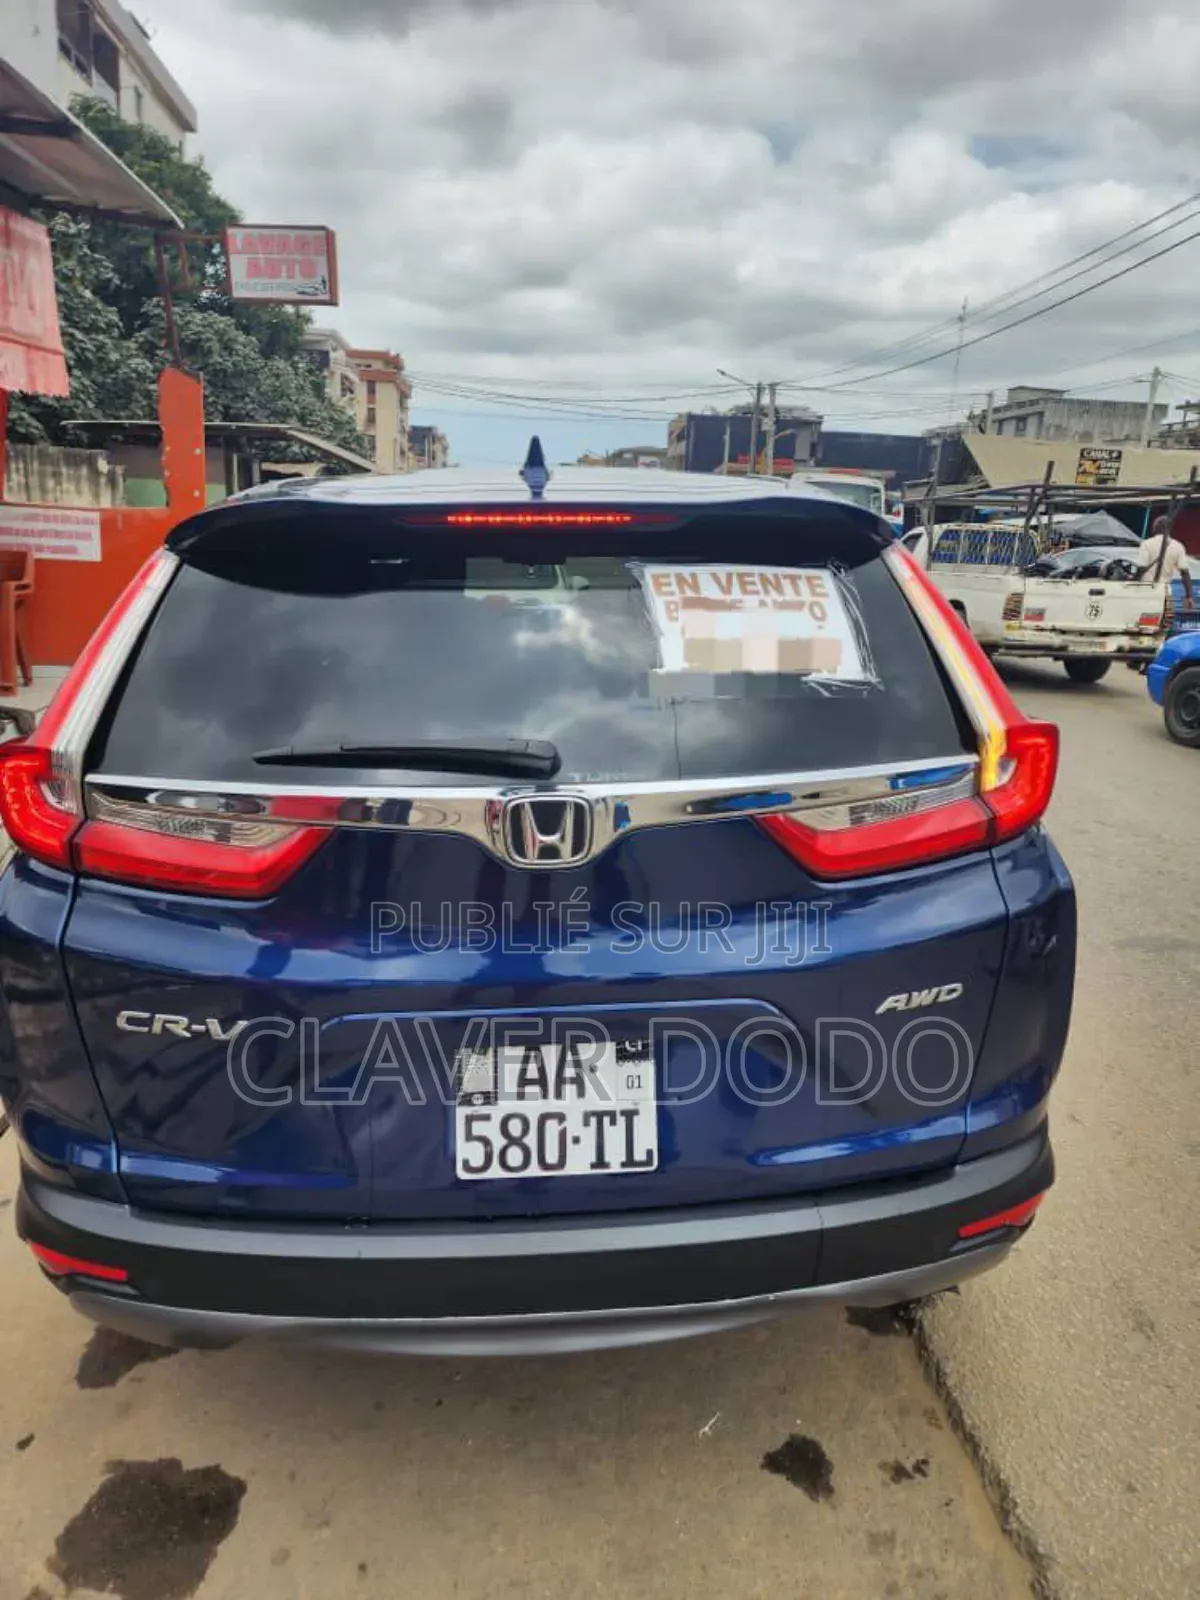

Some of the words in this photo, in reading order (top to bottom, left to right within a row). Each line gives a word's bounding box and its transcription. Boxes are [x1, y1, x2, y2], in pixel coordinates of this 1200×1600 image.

[246, 257, 317, 279] AUTO
[652, 572, 701, 596] EN
[711, 573, 829, 598] VENTE
[875, 982, 963, 1015] AWD
[116, 1010, 249, 1041] CR-V
[516, 1044, 586, 1101] AA
[627, 1074, 643, 1089] 01
